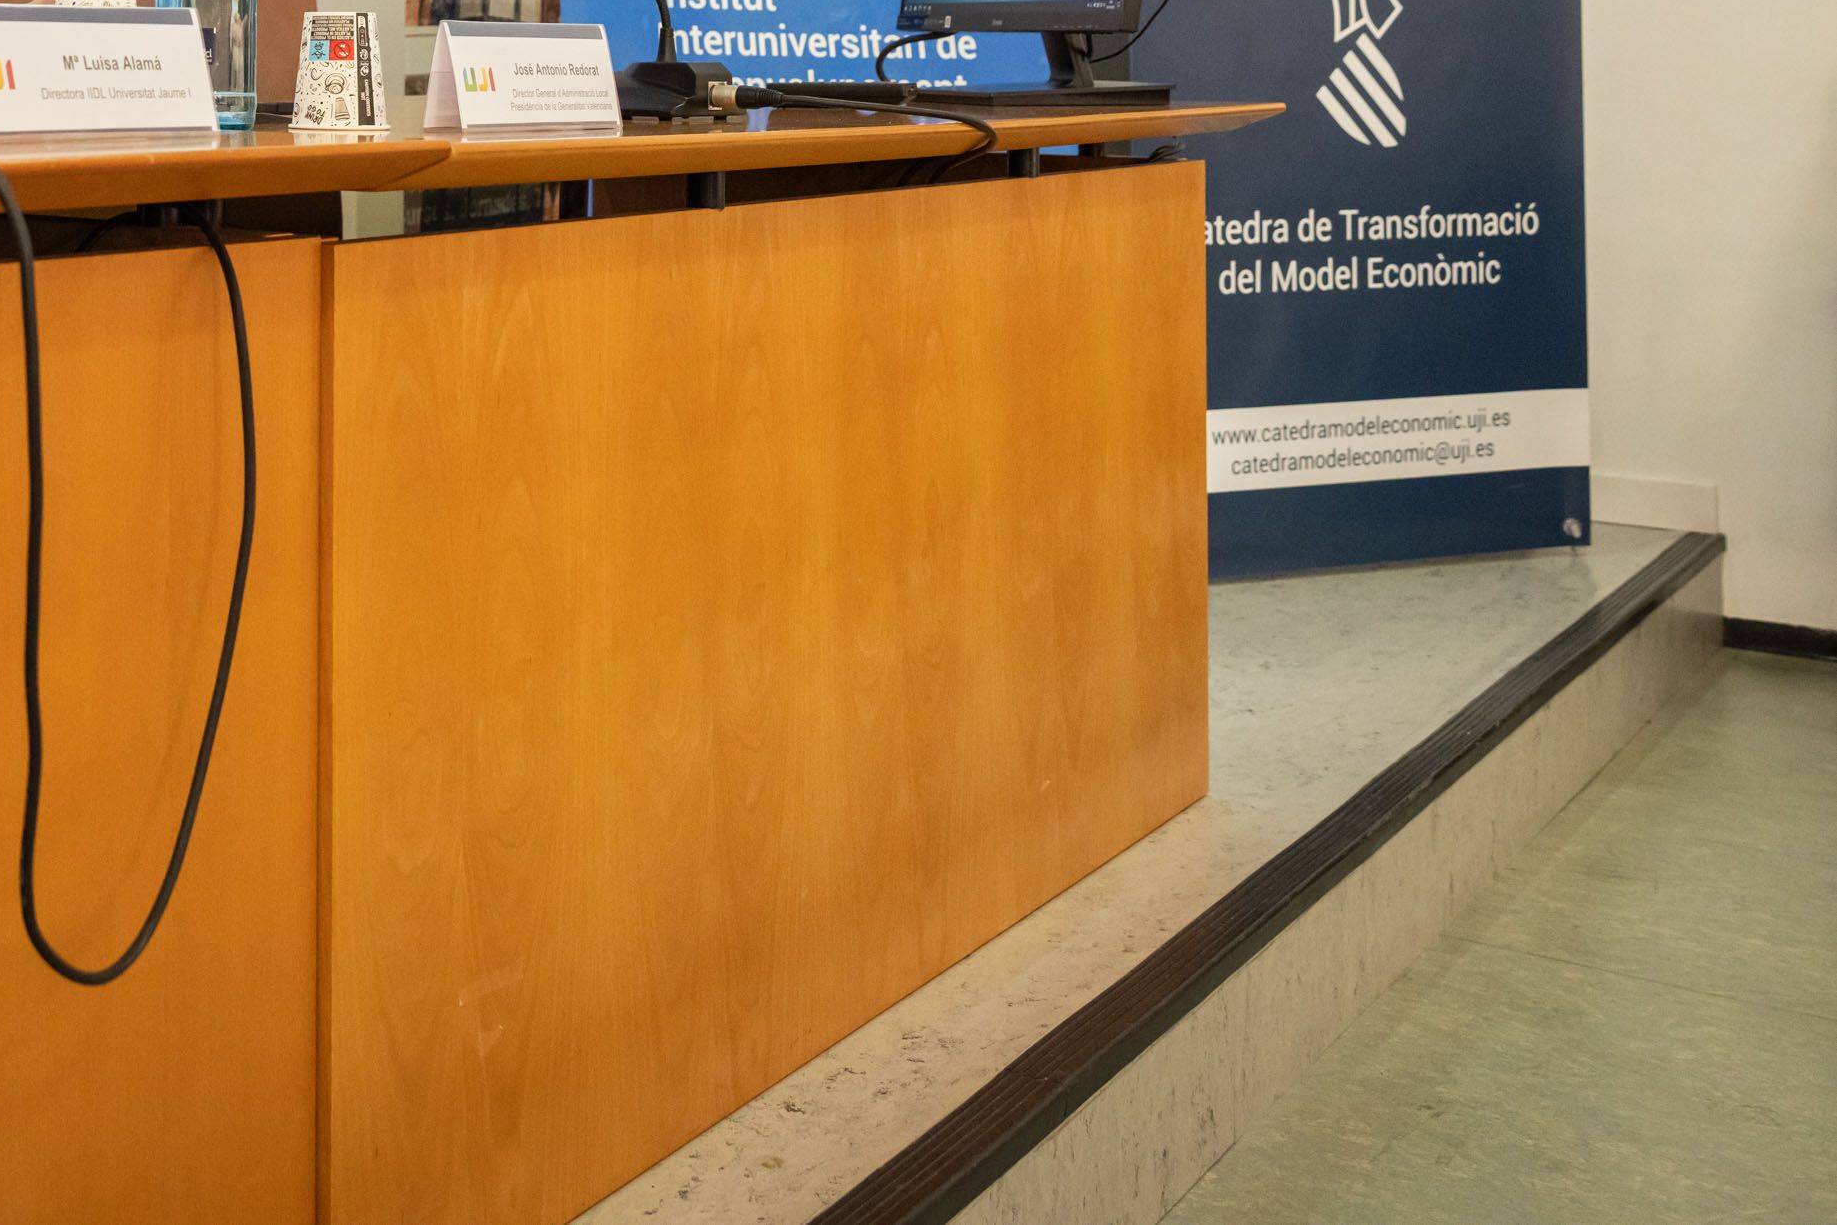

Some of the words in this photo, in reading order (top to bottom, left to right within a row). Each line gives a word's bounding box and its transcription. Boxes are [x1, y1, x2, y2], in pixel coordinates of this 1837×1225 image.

[658, 22, 926, 59] nteruniversitari
[84, 55, 120, 71] Luisa
[123, 55, 161, 71] Alamá
[514, 63, 534, 76] José
[536, 63, 568, 76] Antonio
[569, 64, 600, 77] Redorat
[463, 67, 496, 92] UJI
[41, 87, 85, 100] Directora
[87, 87, 107, 100] IIDL
[109, 86, 156, 99] Universitat
[158, 86, 186, 99] Jaume
[512, 88, 535, 99] Director
[536, 88, 557, 98] General
[596, 89, 609, 98] Local
[304, 110, 324, 125] DRINK
[1297, 208, 1332, 243] de
[1339, 203, 1540, 240] Transformació
[1219, 260, 1262, 295] del
[1271, 256, 1358, 293] Model
[1367, 251, 1501, 290] Econòmic
[1212, 408, 1511, 446] www.catedramodeleconomic.uji.es
[1231, 438, 1495, 476] catedramodeleconomic@uji.es
